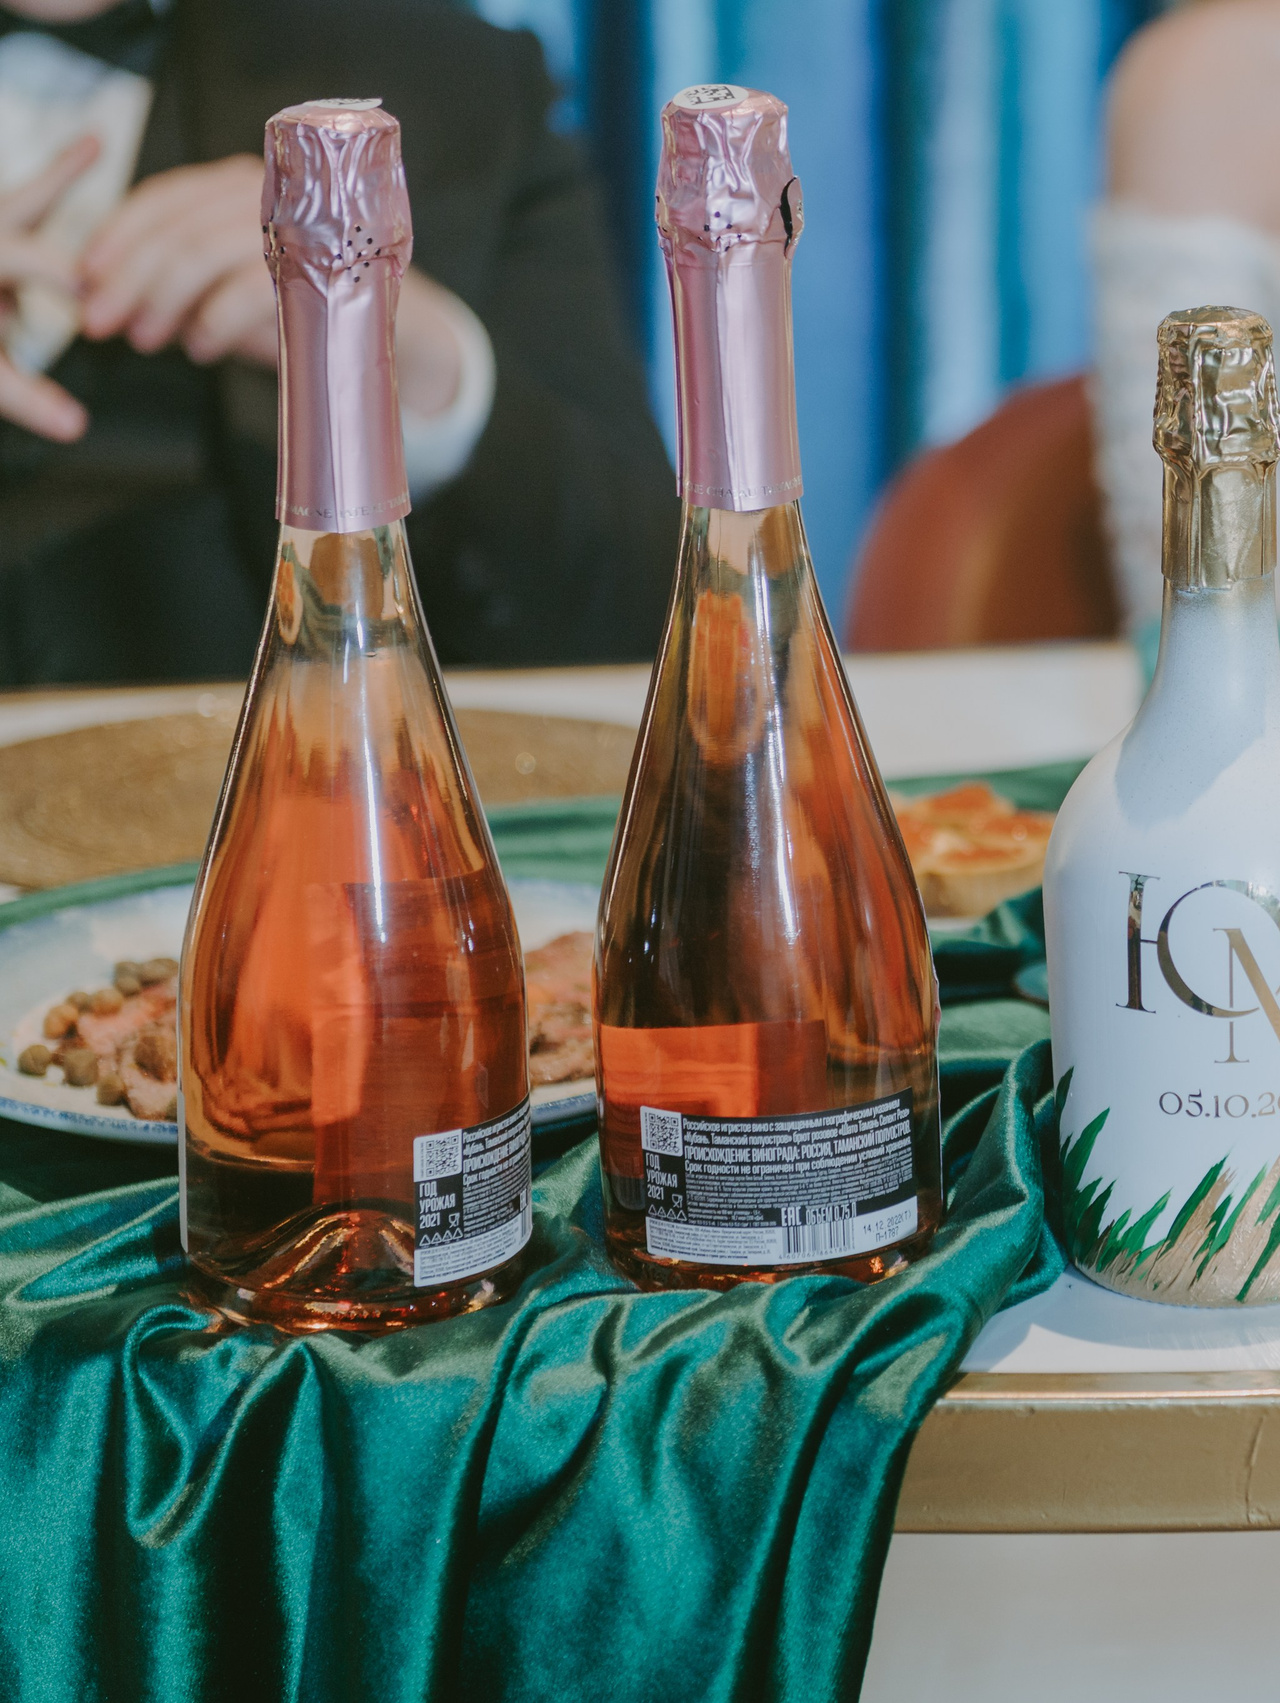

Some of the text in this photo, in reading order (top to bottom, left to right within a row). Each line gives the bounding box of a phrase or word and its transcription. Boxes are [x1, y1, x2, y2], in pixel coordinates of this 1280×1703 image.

[721, 1122, 751, 1135] игристое
[751, 1122, 769, 1133] вино
[684, 1145, 752, 1164] ПРОИСХОЖДЕНИЕ
[752, 1146, 801, 1163] ВИНОГРАДА:
[801, 1141, 834, 1159] РОССИЯ,
[834, 1130, 875, 1155] ТАМАНСКИЙ
[646, 1153, 660, 1171] ГОД
[685, 1160, 703, 1176] Срок
[703, 1164, 740, 1176] годности
[740, 1165, 752, 1175] не
[752, 1162, 795, 1178] ограничен
[795, 1160, 811, 1174] при
[811, 1153, 859, 1171] соблюдении
[858, 1144, 886, 1164] условий
[646, 1168, 678, 1188] УРОЖАЯ
[419, 1180, 438, 1198] ГОД
[647, 1184, 664, 1201] 2021
[419, 1193, 456, 1214] УРОЖАЯ
[419, 1212, 440, 1229] 2021
